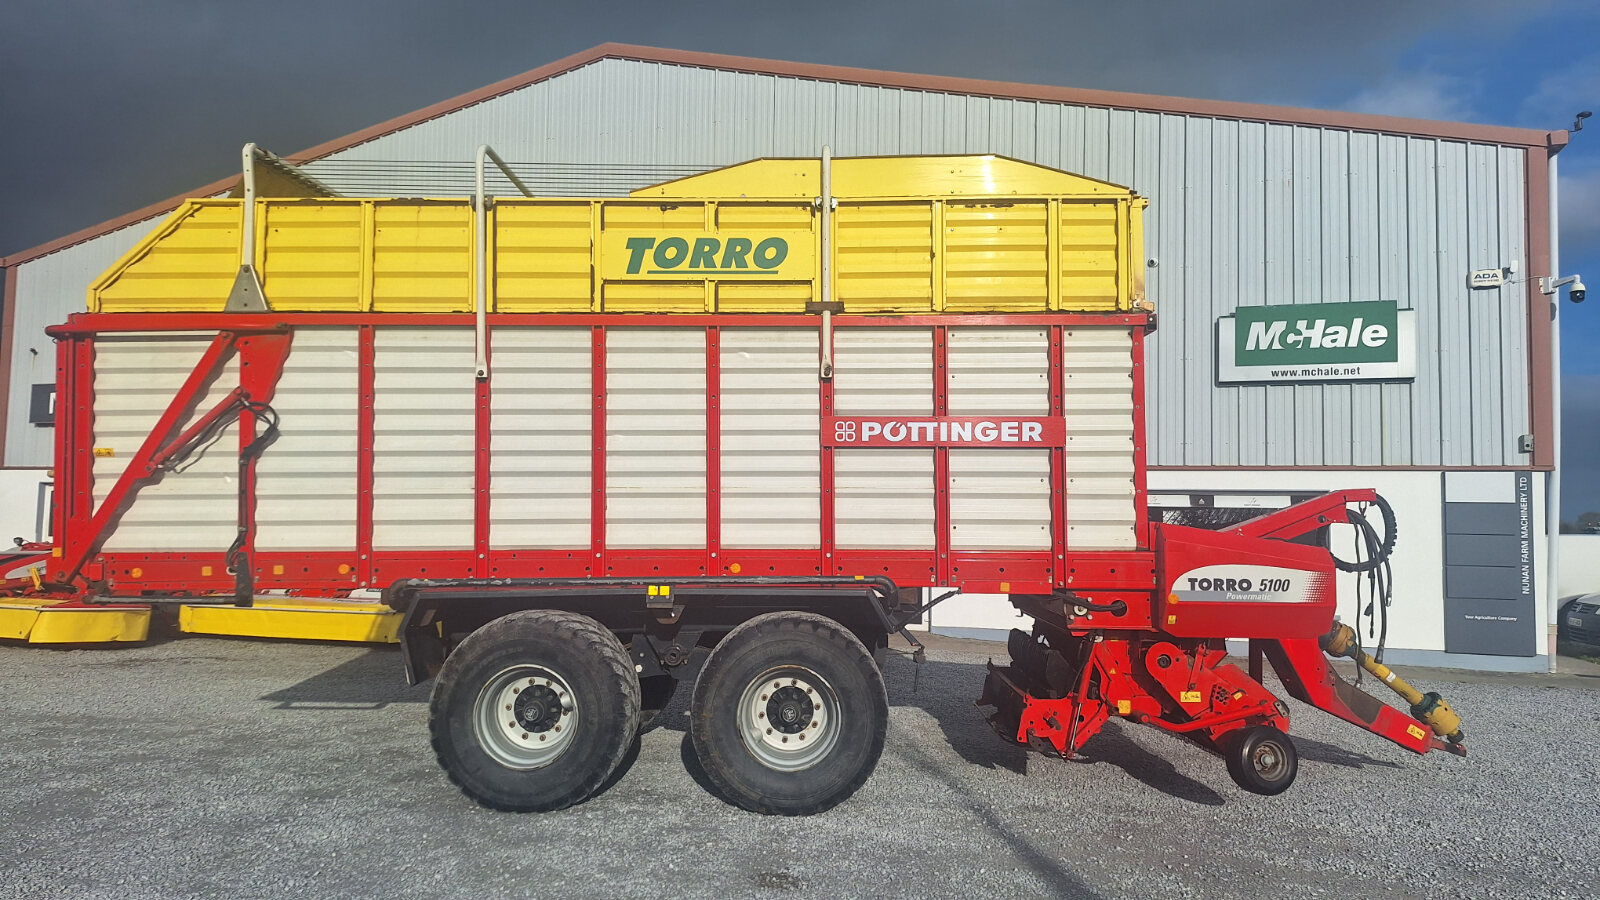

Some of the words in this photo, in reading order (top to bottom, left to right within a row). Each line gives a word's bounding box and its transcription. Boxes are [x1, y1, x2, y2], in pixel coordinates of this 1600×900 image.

[625, 237, 789, 274] TORRO
[1474, 272, 1499, 280] ADA
[1245, 318, 1389, 350] McHale
[1271, 366, 1361, 377] www.mchale.net
[1519, 476, 1528, 491] LTD
[1520, 492, 1529, 538] MACHINERY
[1521, 541, 1529, 562] FARM
[1188, 578, 1252, 591] TORRO
[1259, 579, 1290, 592] 5100
[1521, 565, 1530, 595] NUNAN
[1226, 592, 1272, 601] Powermatic
